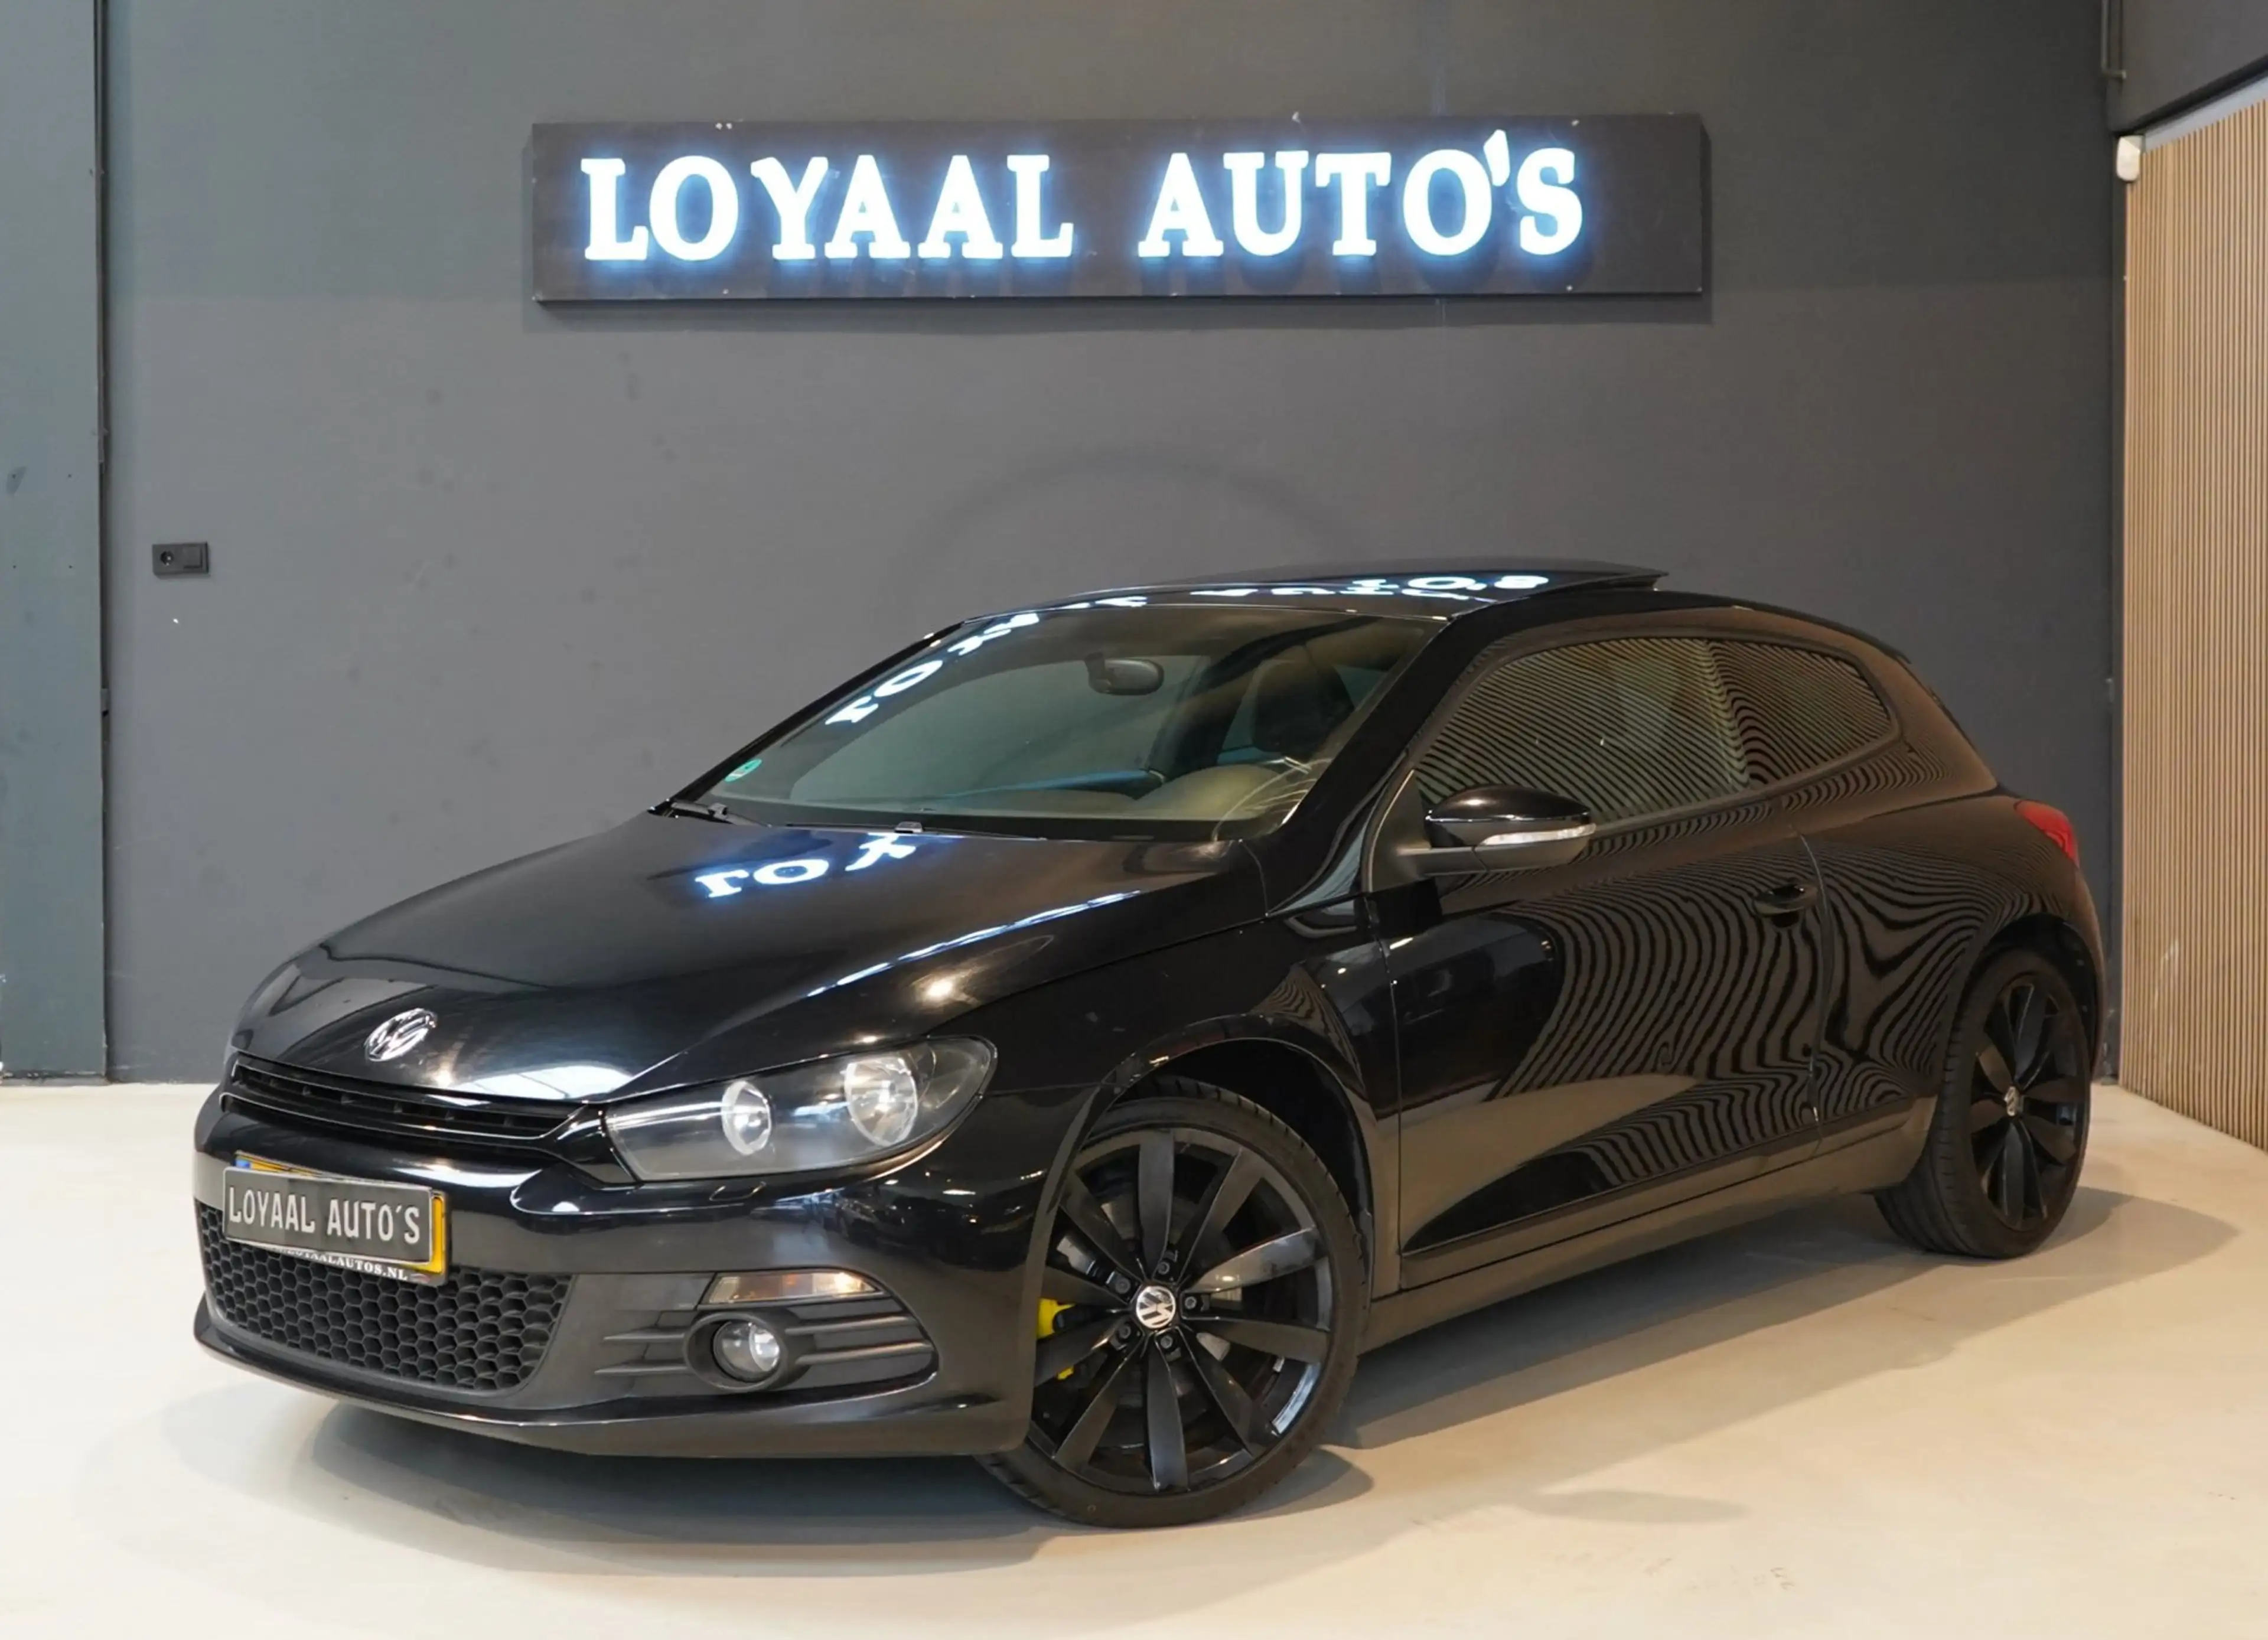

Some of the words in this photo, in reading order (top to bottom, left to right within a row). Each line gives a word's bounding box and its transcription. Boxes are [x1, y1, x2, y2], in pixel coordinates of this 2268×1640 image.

[581, 155, 1074, 261] LOYAAL
[1138, 130, 1582, 257] AUTO'S
[229, 1186, 316, 1234] LOYAAL
